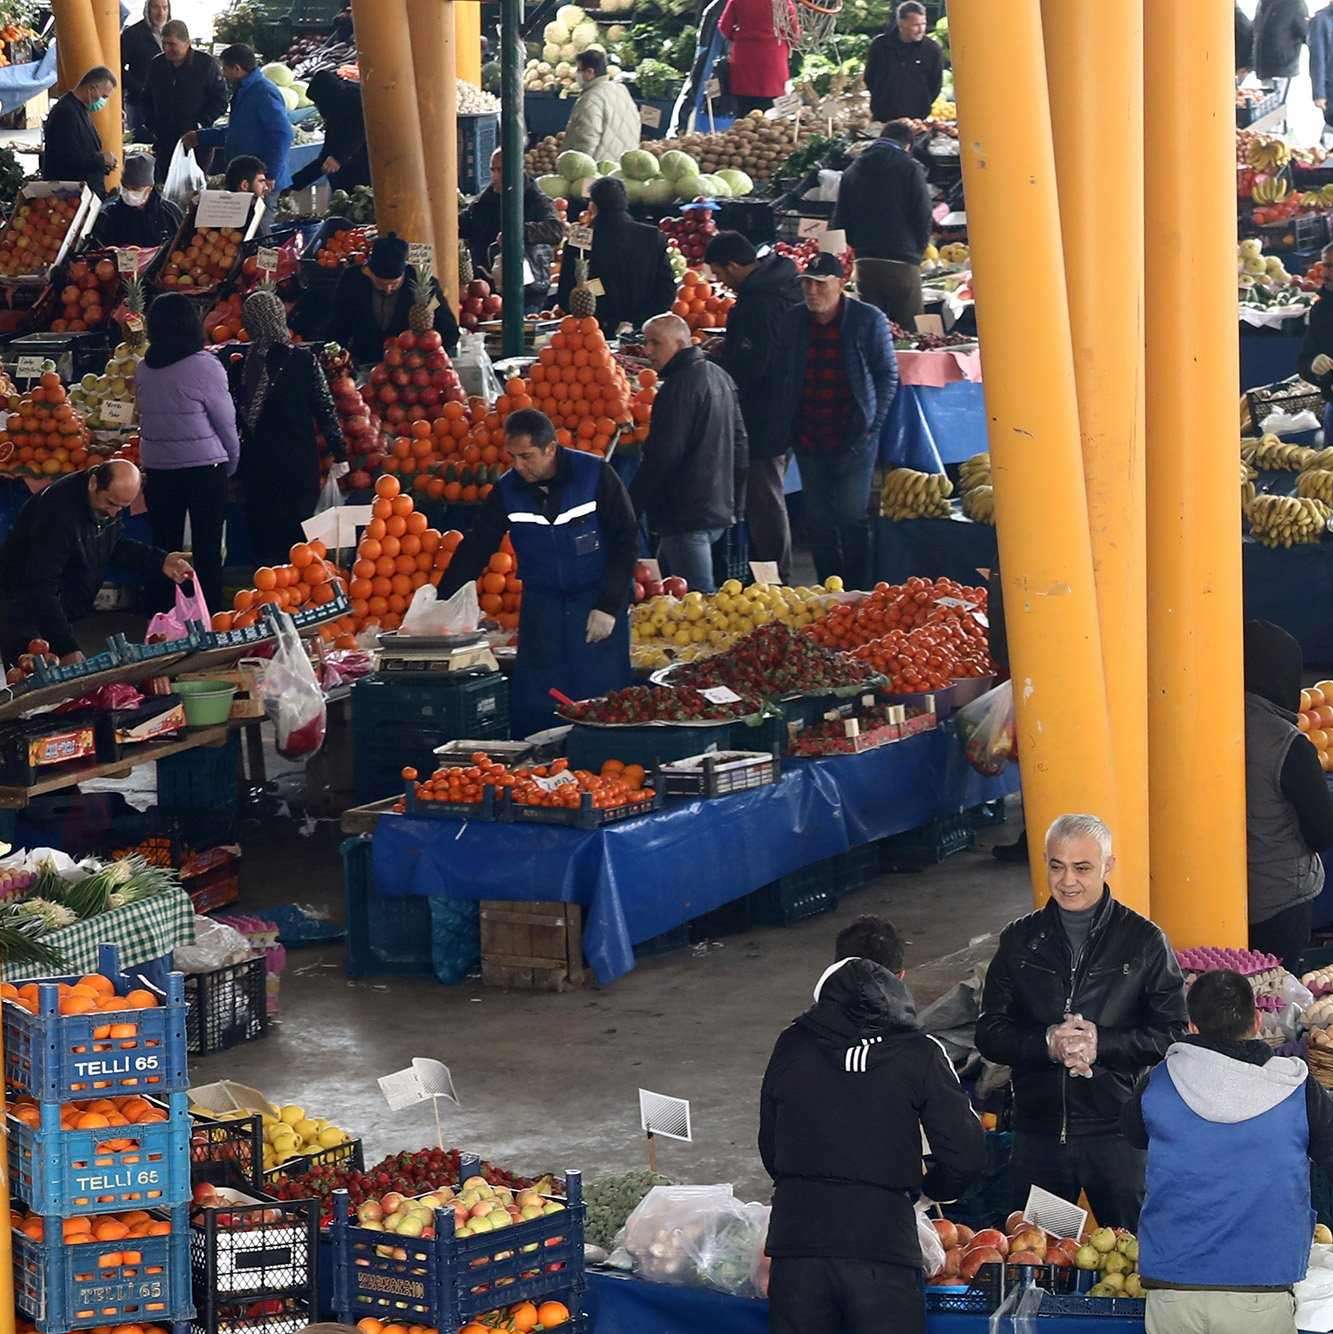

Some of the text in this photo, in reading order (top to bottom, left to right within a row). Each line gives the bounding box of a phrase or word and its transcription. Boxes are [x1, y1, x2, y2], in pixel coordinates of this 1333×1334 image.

[75, 1056, 159, 1076] TELLİ 65
[76, 1170, 160, 1191] TELLİ 65
[140, 1283, 161, 1297] 65
